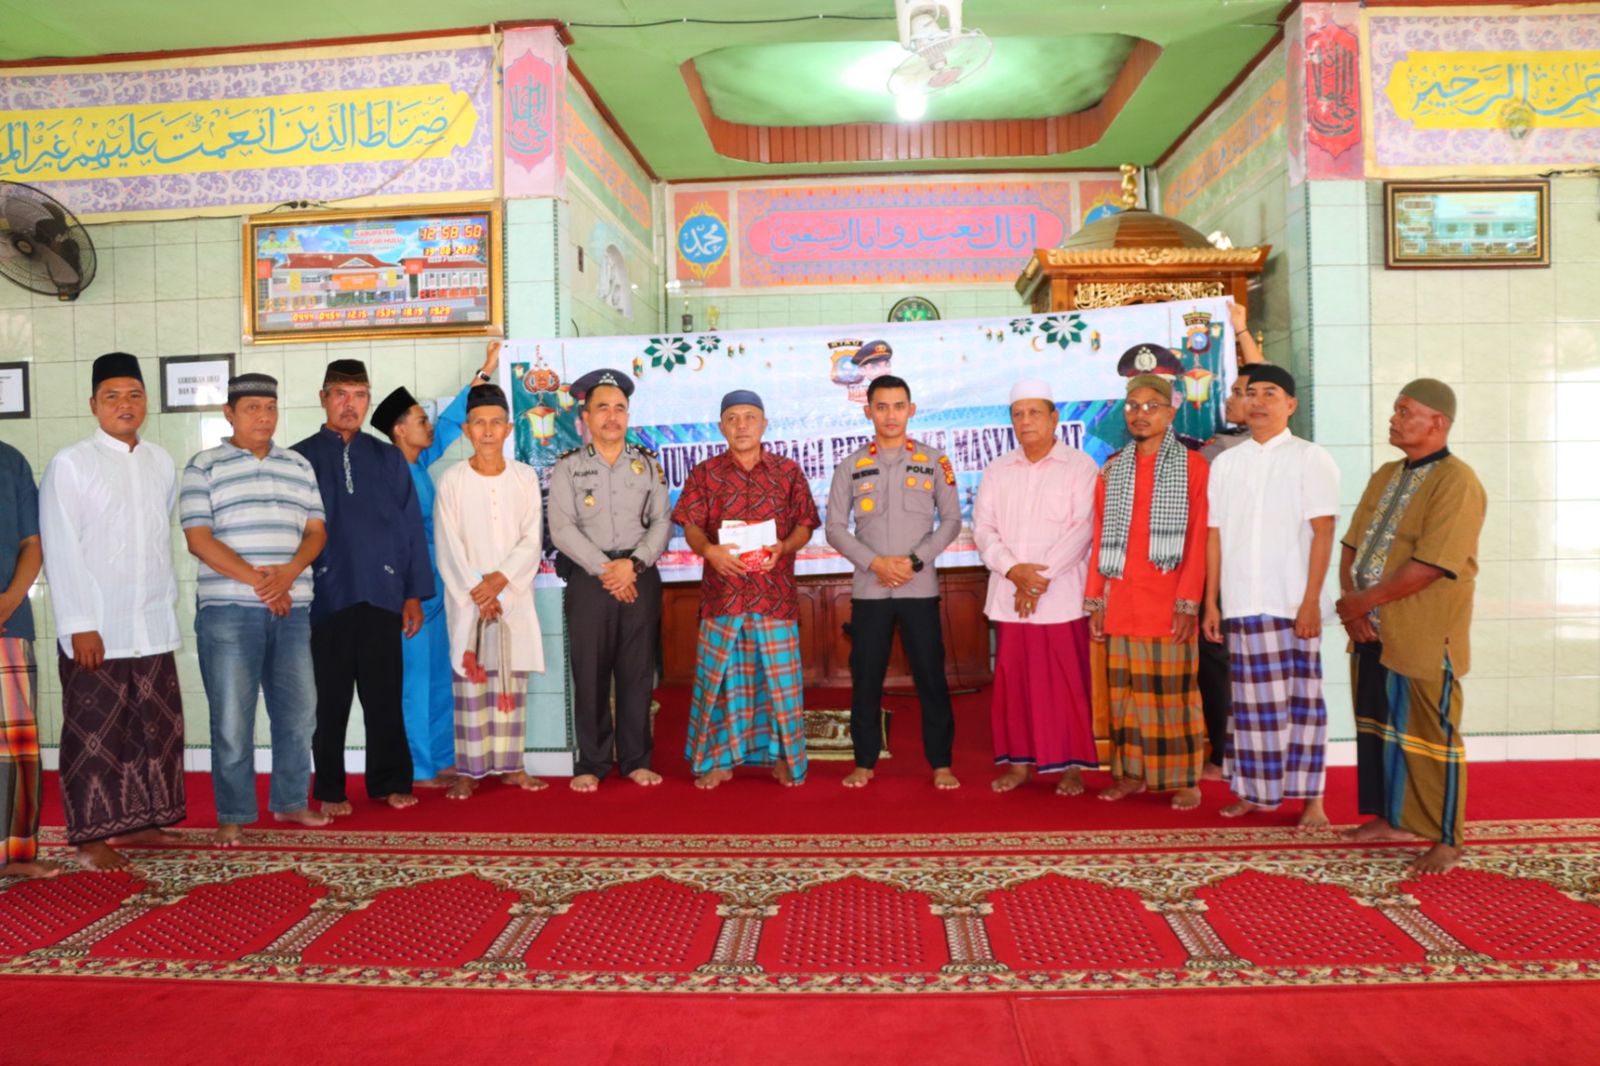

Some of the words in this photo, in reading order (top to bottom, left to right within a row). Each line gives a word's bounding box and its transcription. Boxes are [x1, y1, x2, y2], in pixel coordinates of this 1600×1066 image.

[421, 227, 436, 240] 12
[442, 226, 458, 239] 58
[464, 225, 482, 238] 50
[661, 443, 727, 488] JUM'
[953, 424, 1083, 472] MASYAAT
[906, 465, 934, 476] POLRI
